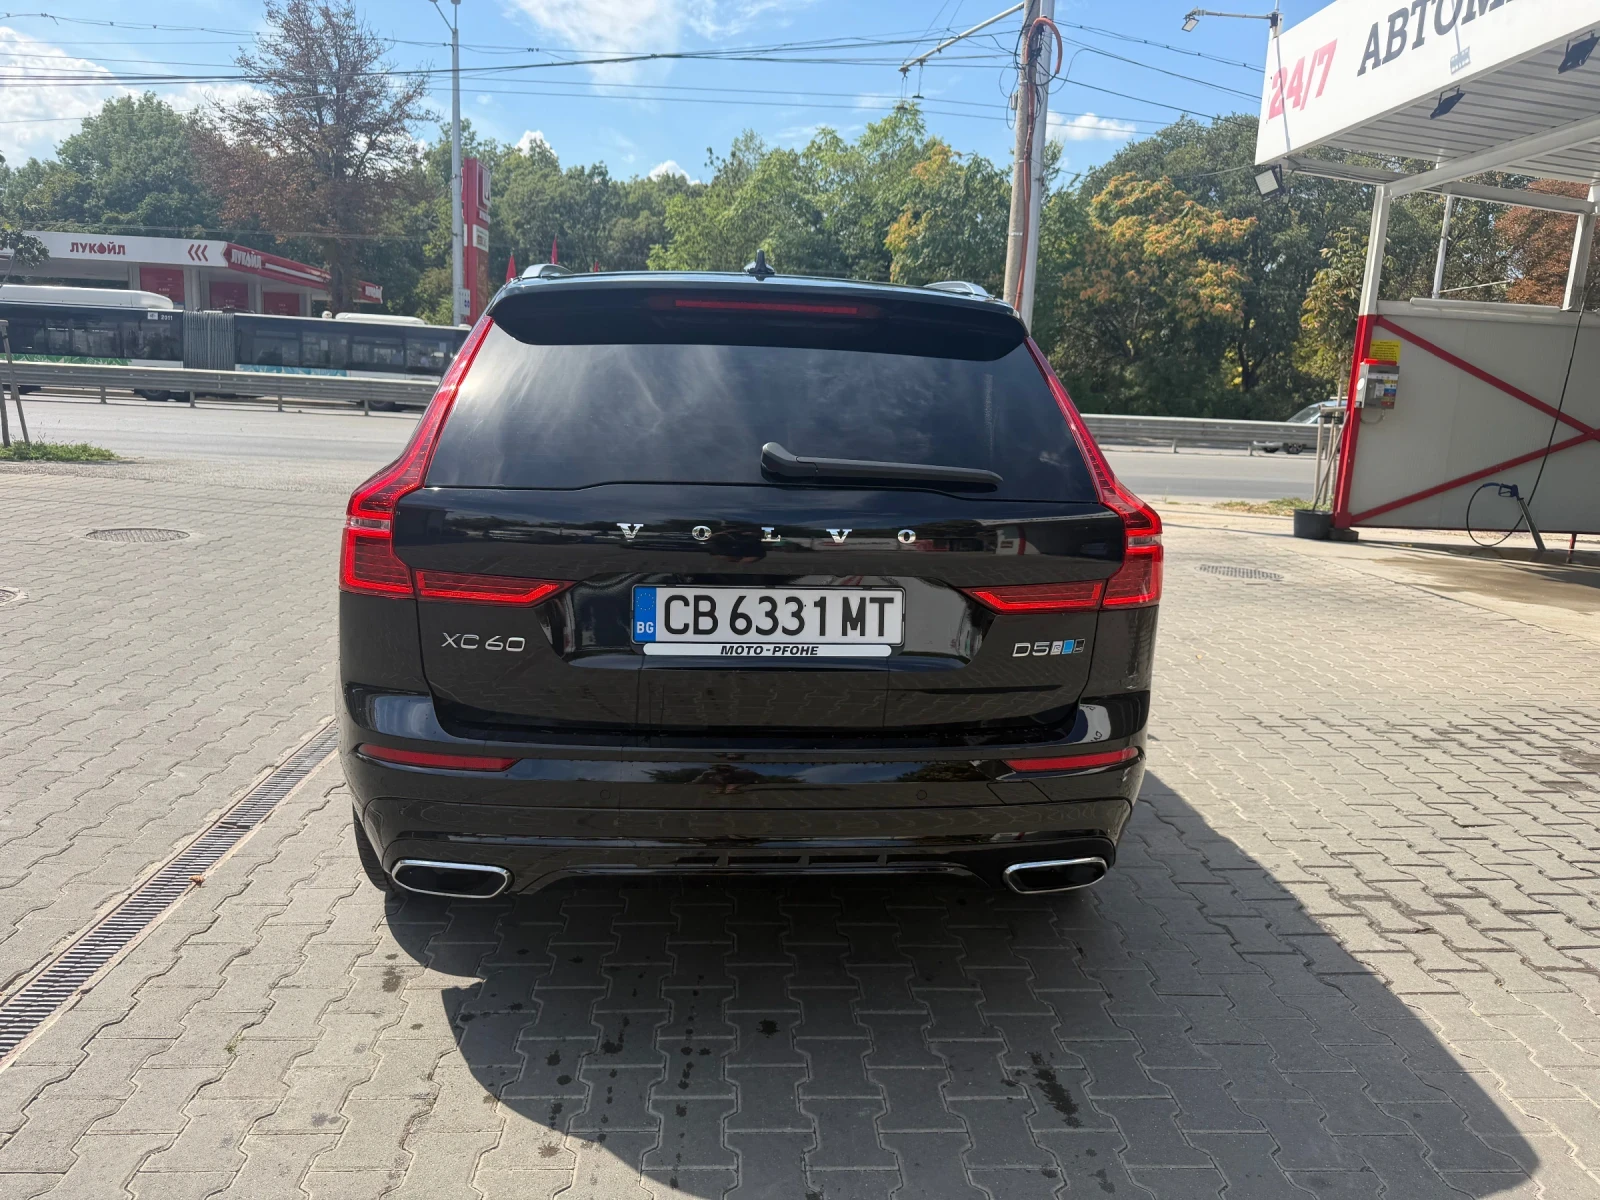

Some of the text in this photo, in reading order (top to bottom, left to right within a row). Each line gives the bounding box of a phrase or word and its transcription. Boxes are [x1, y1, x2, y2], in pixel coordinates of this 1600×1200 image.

[1268, 0, 1514, 120] 24/7 АВТО
[70, 241, 126, 256] ЛУКОЙЛ
[616, 522, 917, 544] VOLVO
[729, 595, 827, 636] 6331
[636, 621, 654, 634] BG
